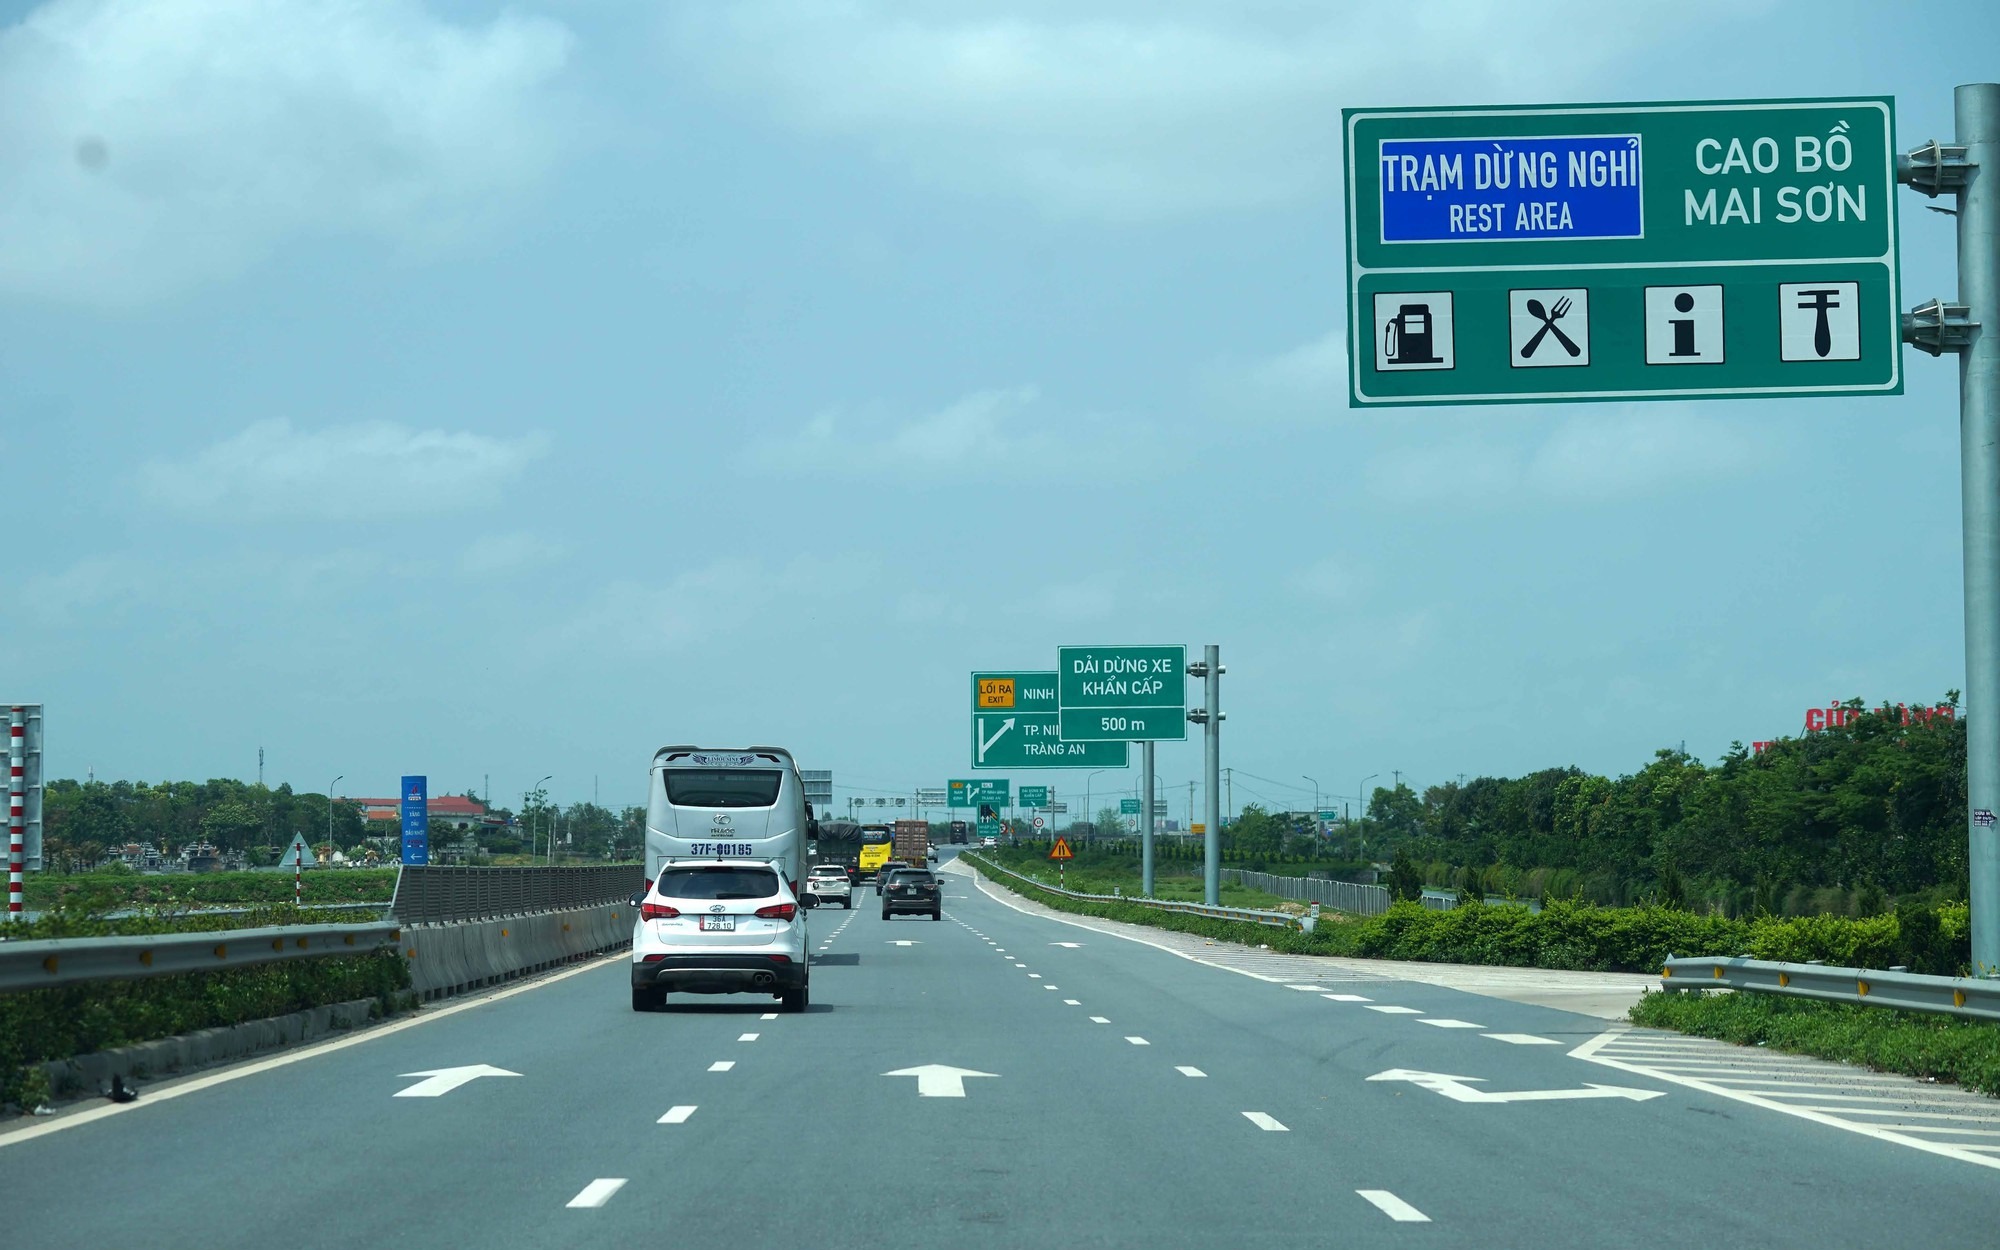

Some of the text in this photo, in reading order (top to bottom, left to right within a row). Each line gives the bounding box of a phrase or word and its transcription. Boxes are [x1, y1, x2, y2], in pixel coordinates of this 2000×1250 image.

[1695, 120, 1853, 176] CAO BỒ
[1383, 138, 1639, 201] TRẠM DỪNG NGHỈ
[1684, 183, 1867, 226] MAI SƠN
[1450, 201, 1574, 233] REST AREA
[1074, 655, 1172, 674] DẢI DỪNG XE
[980, 682, 1012, 694] LỐI RA
[1082, 675, 1162, 696] KHẨN CẤP
[988, 696, 1004, 704] EXIT
[1024, 688, 1054, 700] NINH
[1023, 725, 1040, 736] TP.
[1101, 717, 1145, 732] 500 m
[1024, 742, 1086, 755] TRÀNG AN
[691, 843, 752, 855] 37F-00185
